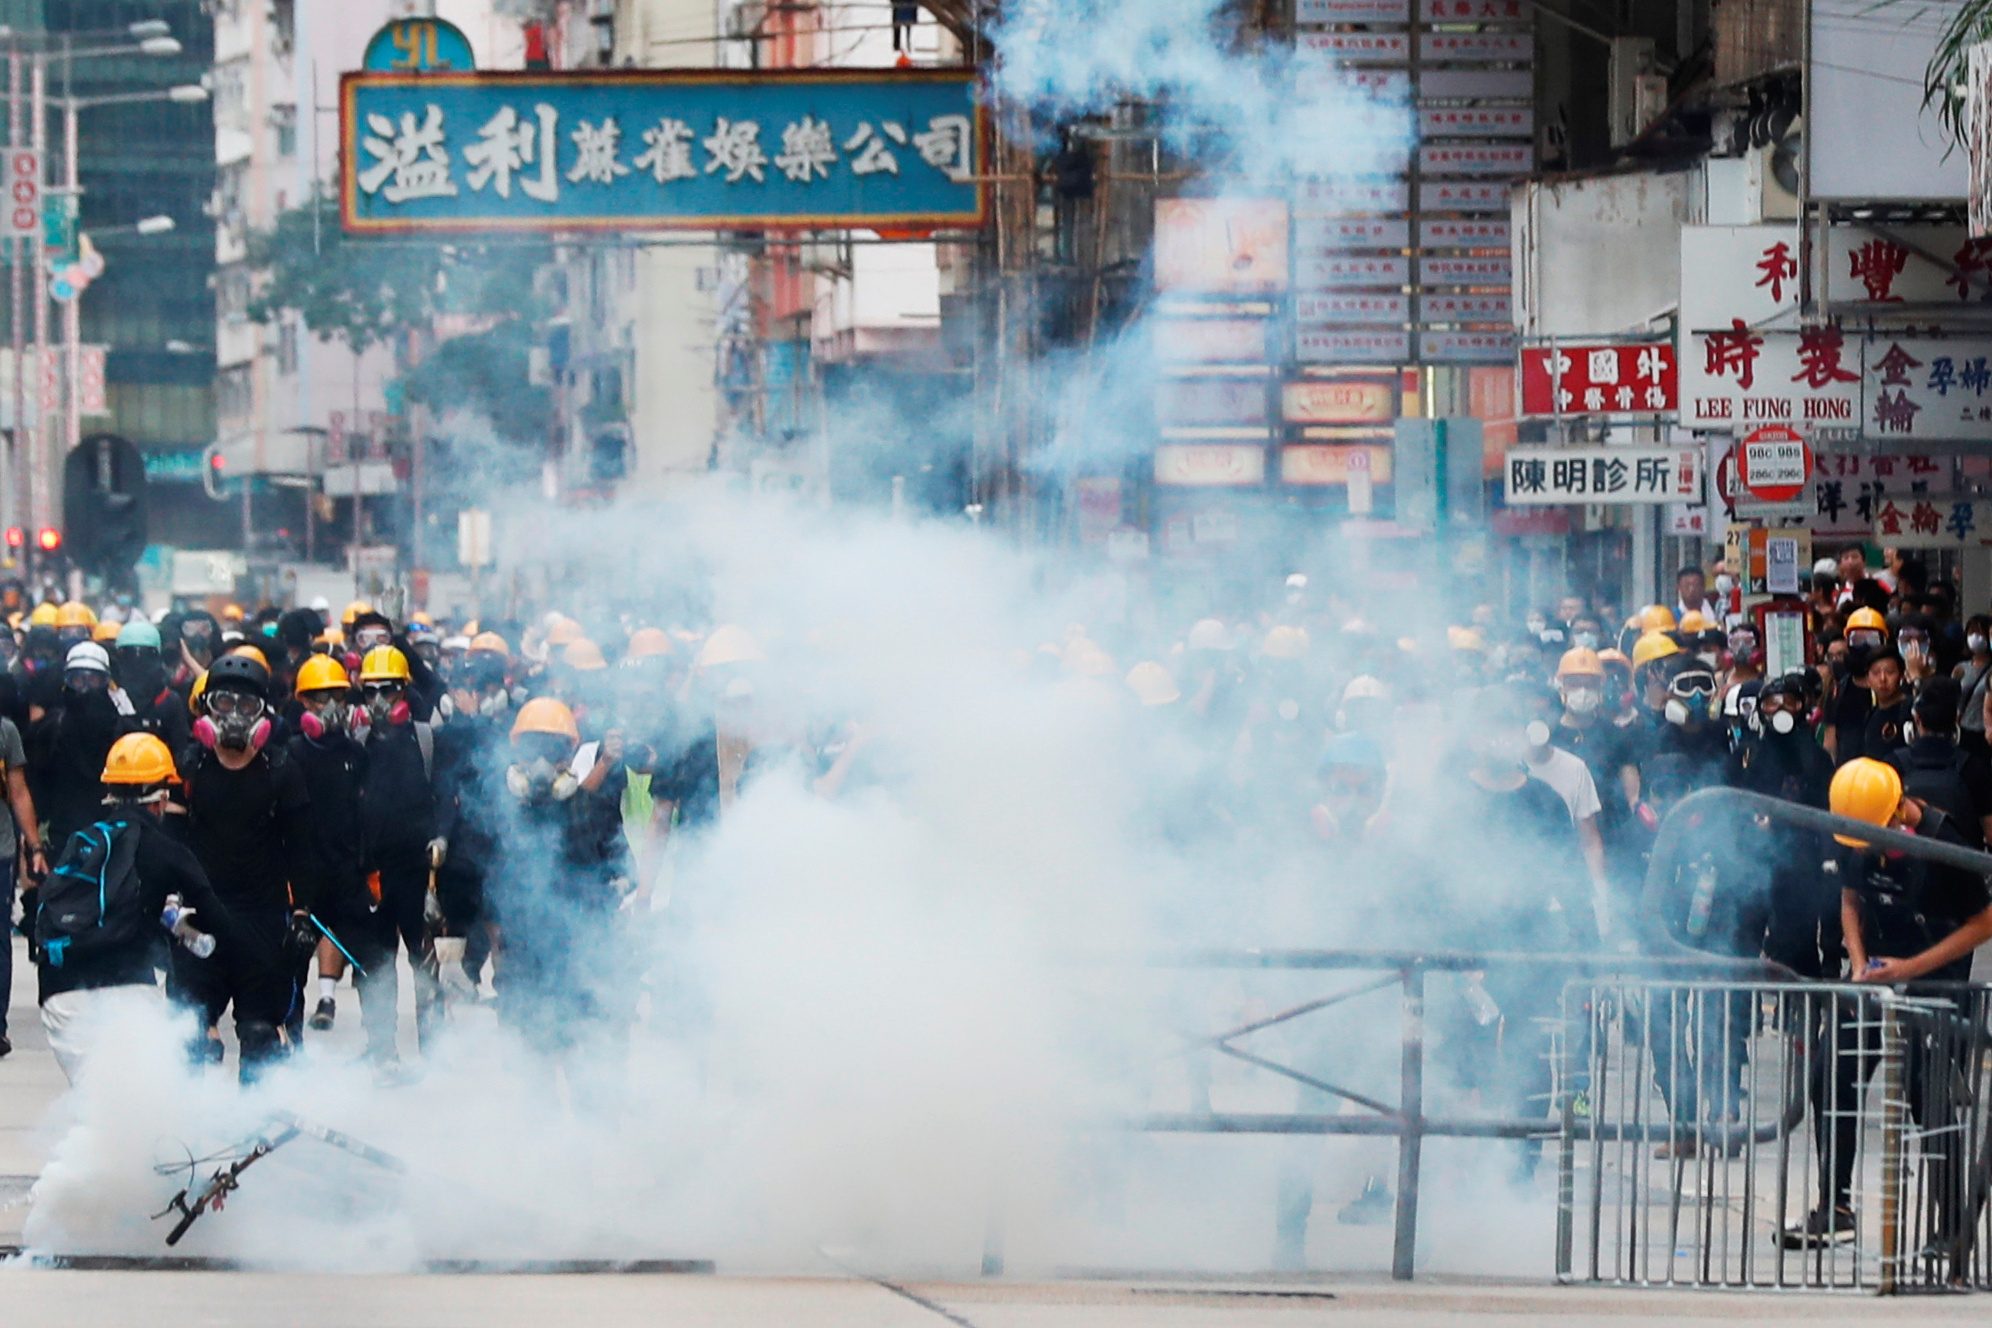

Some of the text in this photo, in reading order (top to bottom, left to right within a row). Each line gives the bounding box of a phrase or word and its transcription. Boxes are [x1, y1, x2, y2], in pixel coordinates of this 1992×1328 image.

[1694, 397, 1852, 419] LEE FUNG HONG
[1512, 457, 1671, 494] 陳明診所
